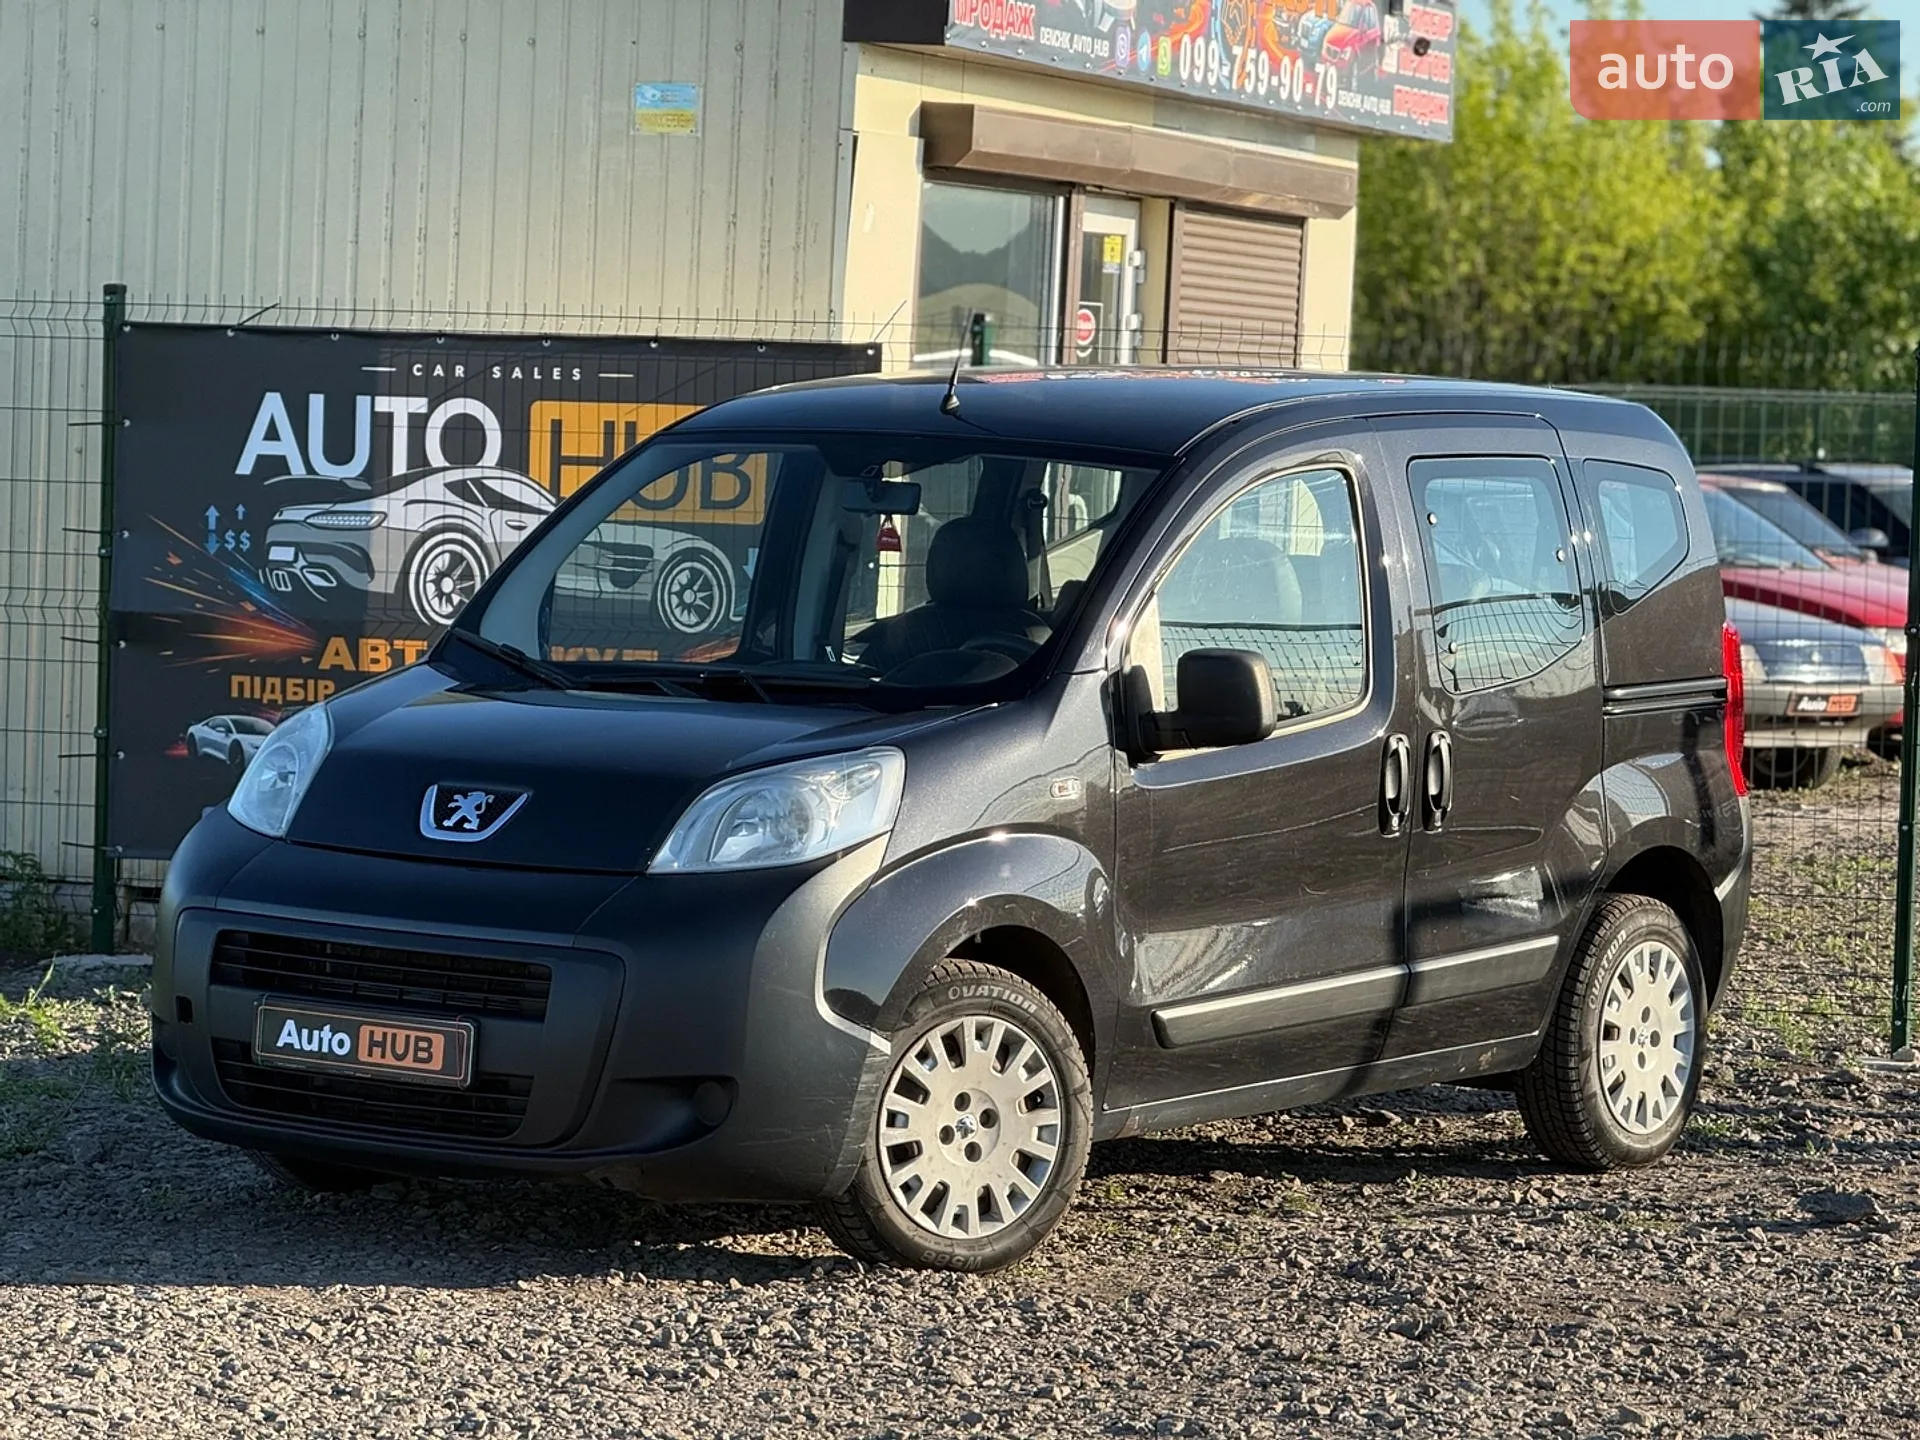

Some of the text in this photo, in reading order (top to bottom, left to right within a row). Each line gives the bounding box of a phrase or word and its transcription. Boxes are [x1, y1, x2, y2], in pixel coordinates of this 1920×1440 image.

[1179, 33, 1338, 110] 099-759-90-79
[412, 363, 582, 381] CAR SALES
[235, 391, 502, 478] AUTO
[231, 675, 335, 705] ПІДБІР
[947, 984, 1038, 1014] OVATION
[276, 1018, 434, 1064] Auto HUB
